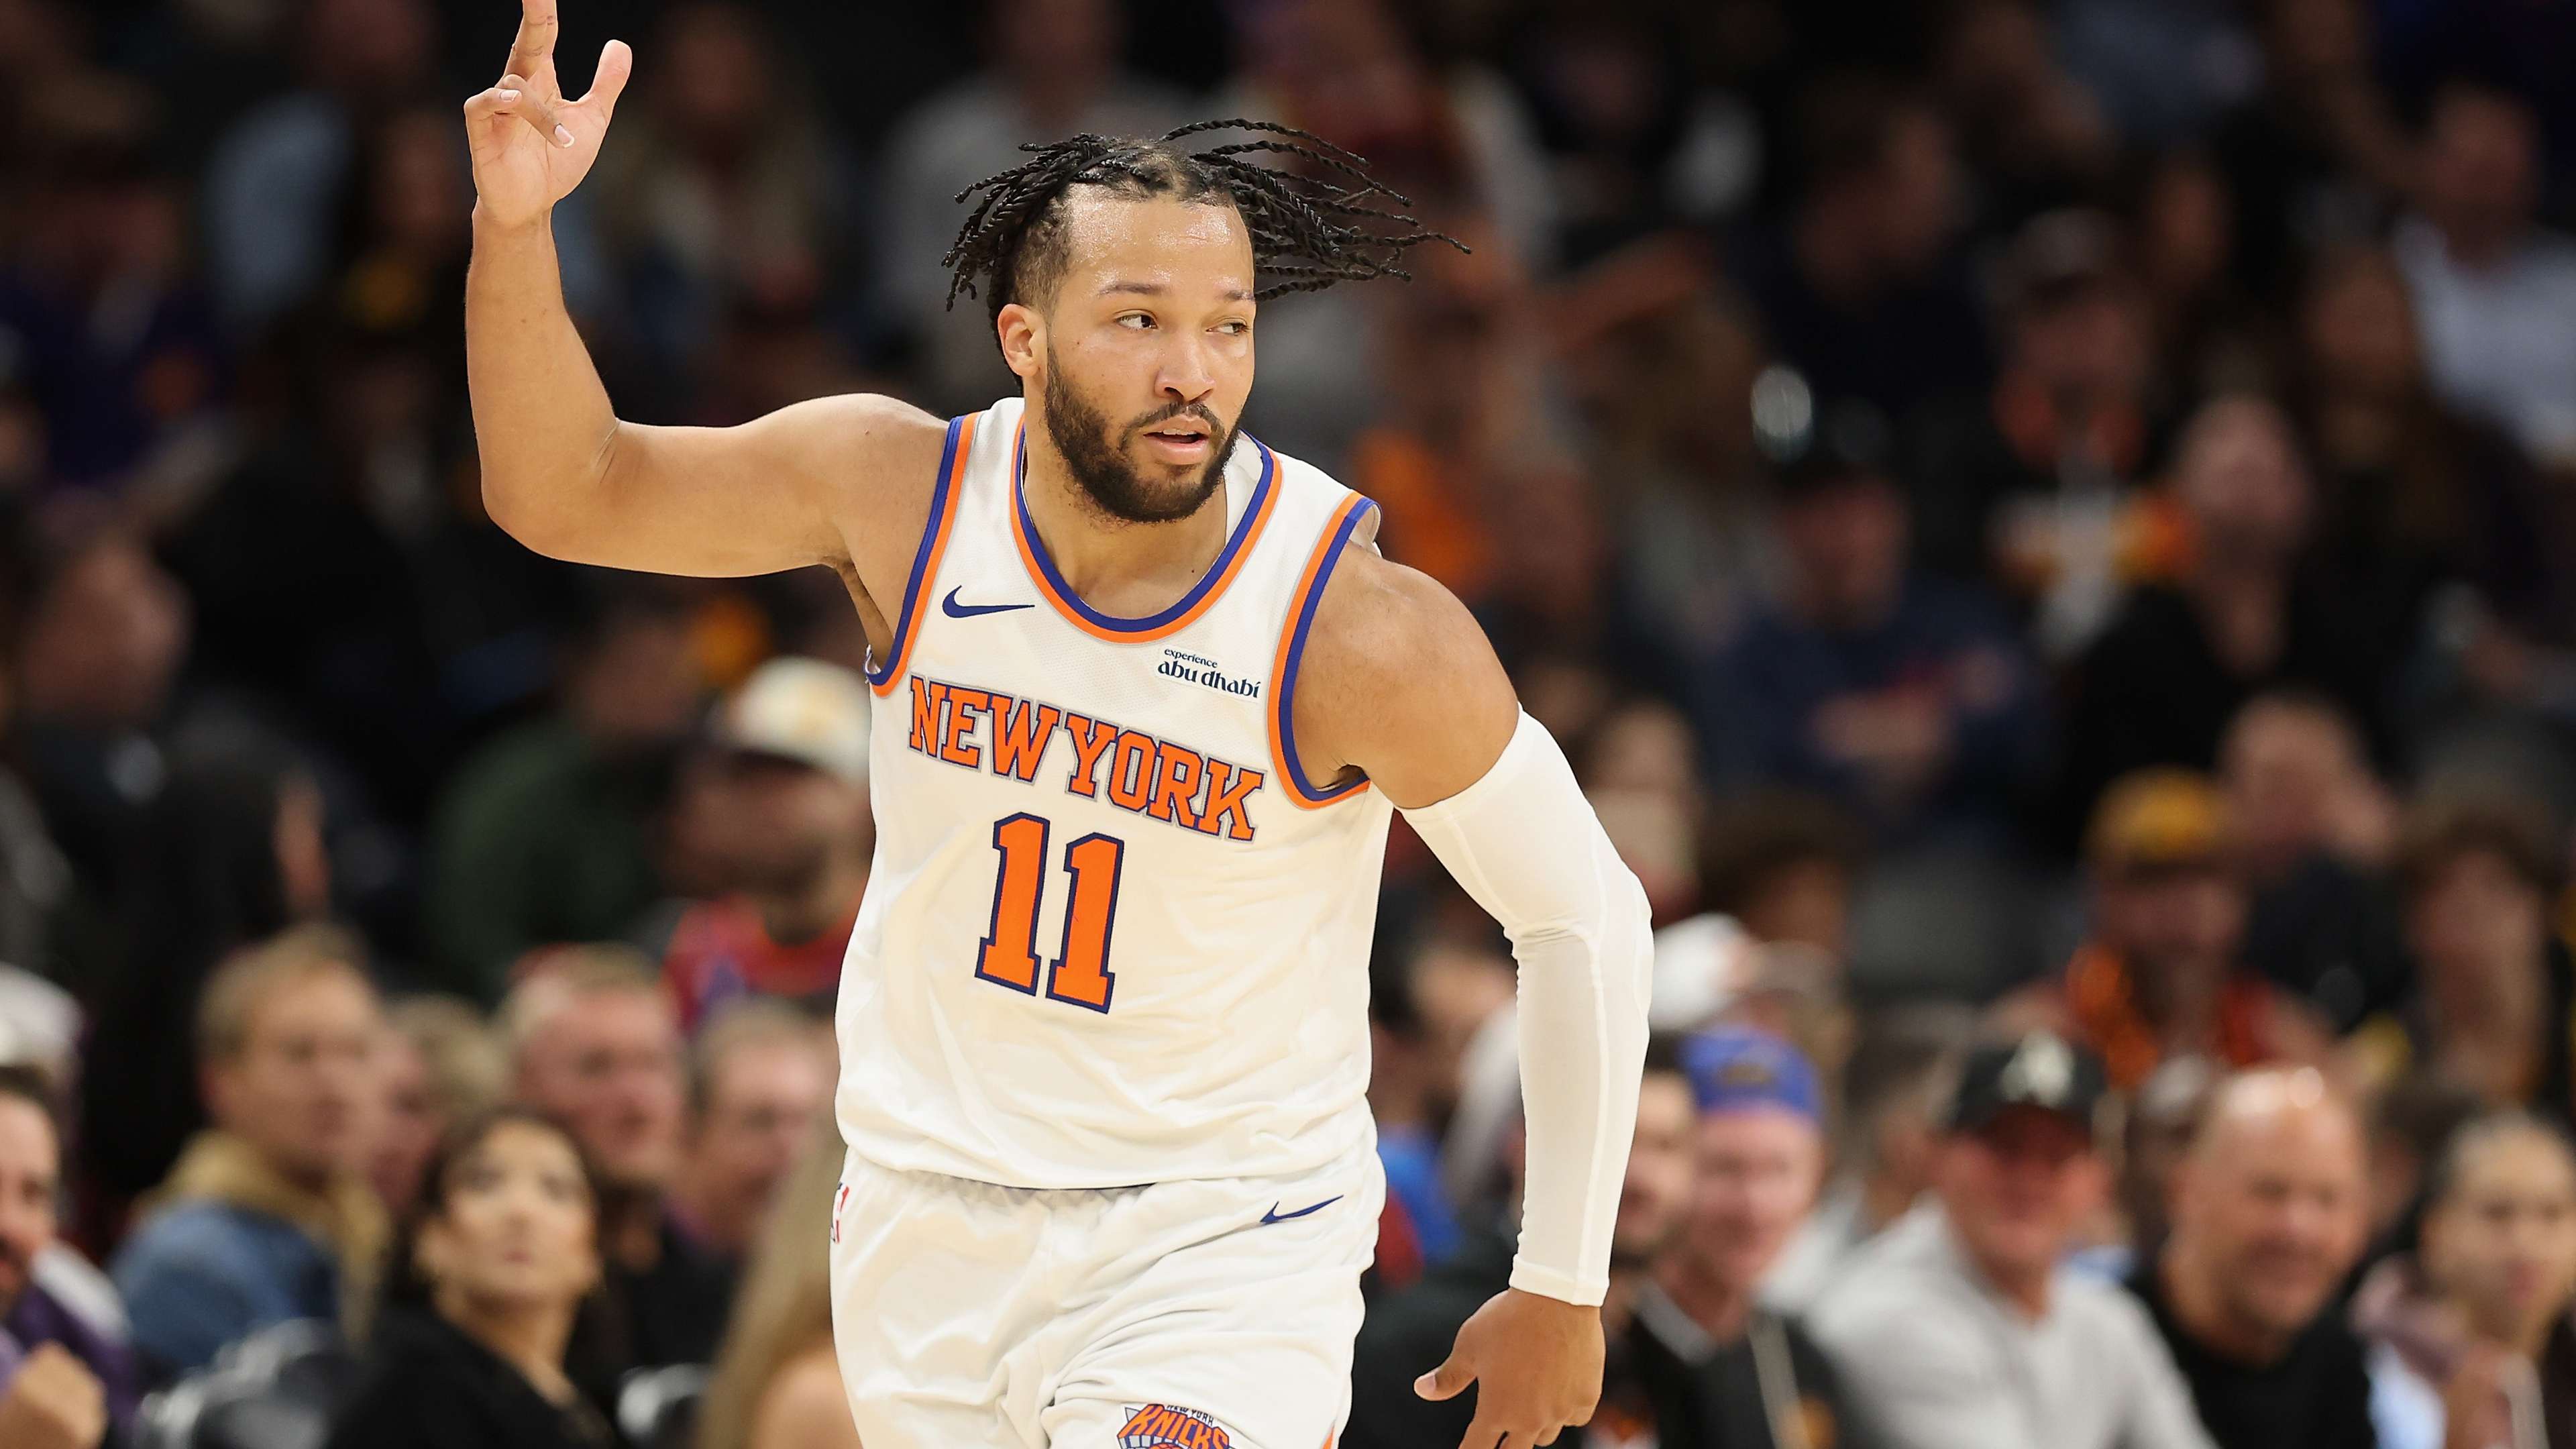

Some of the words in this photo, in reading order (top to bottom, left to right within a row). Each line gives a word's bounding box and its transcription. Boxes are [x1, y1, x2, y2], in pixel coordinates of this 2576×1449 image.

[1157, 660, 1198, 682] abu
[1201, 671, 1261, 698] dhabi
[1164, 648, 1218, 668] experience
[909, 674, 1061, 785] NEW
[1065, 707, 1267, 843] YORK
[974, 811, 1125, 1014] 11
[1117, 1403, 1230, 1449] KNICKS
